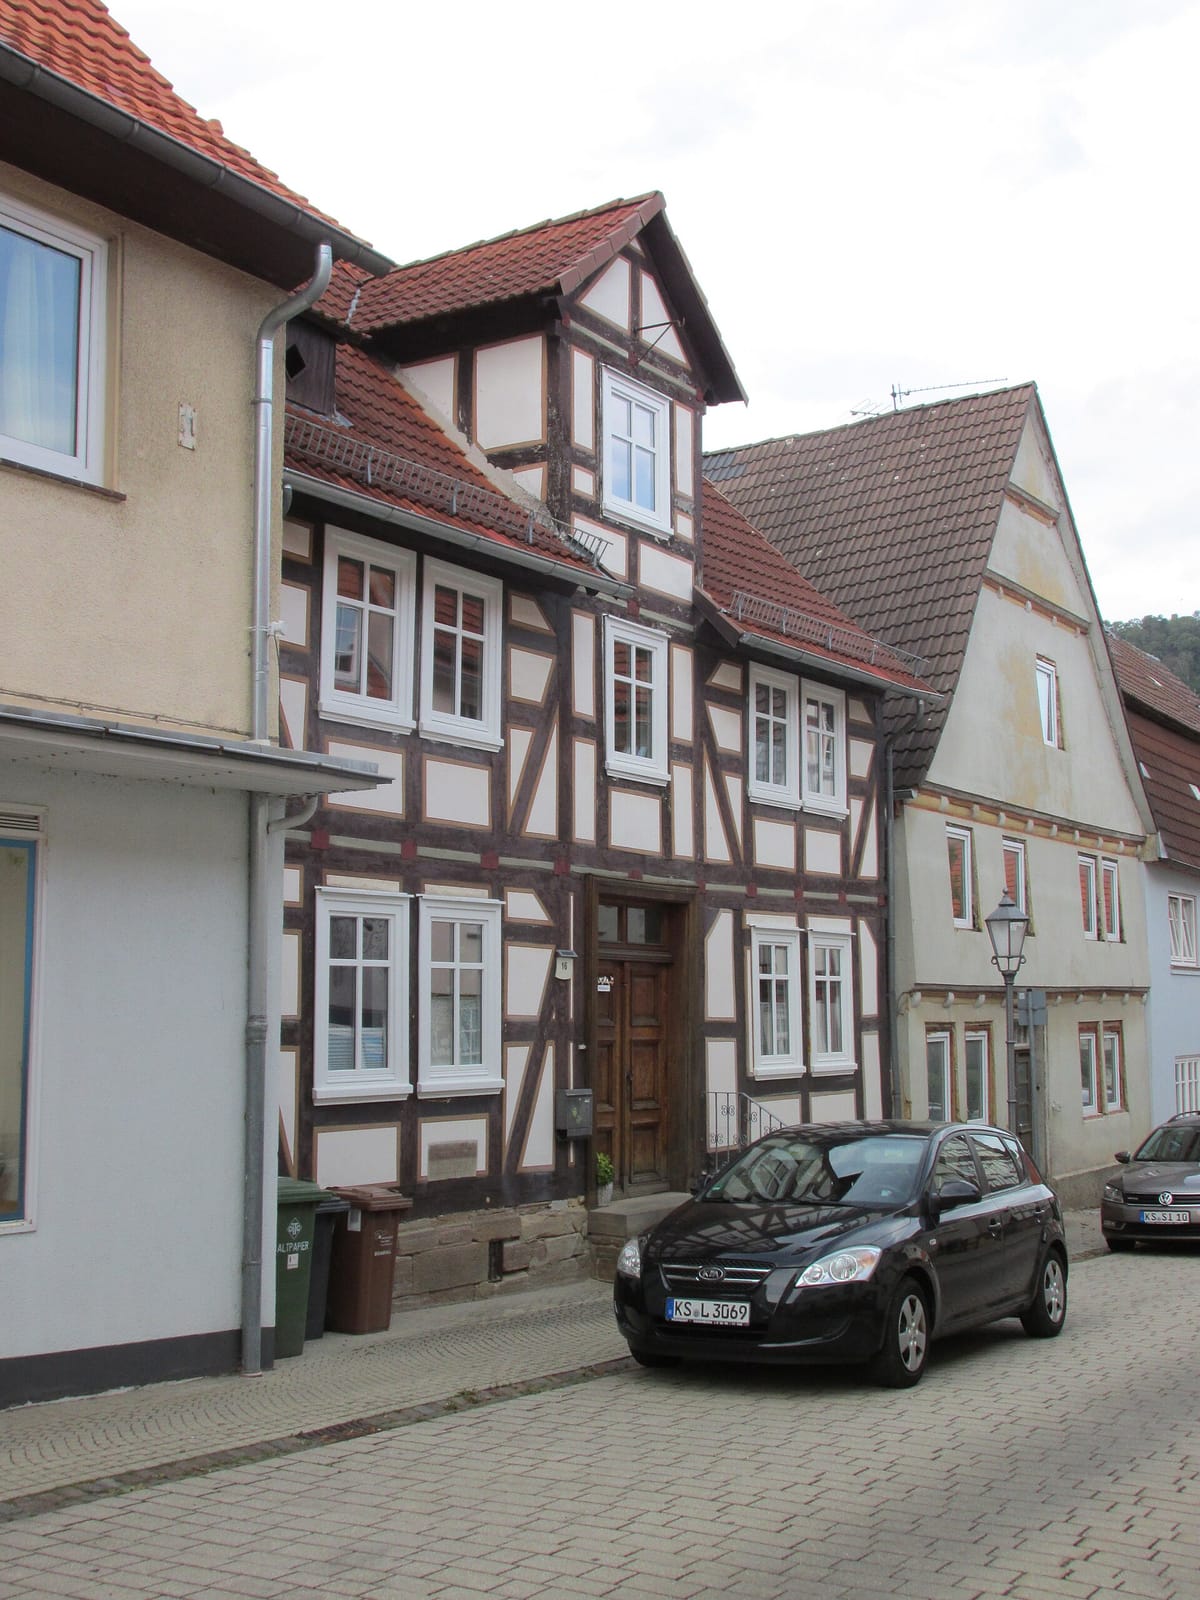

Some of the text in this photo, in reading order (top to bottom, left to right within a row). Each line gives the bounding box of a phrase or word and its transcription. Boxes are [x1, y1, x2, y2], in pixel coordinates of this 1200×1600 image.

[1144, 1212, 1157, 1221] KS
[1176, 1213, 1188, 1222] 10
[277, 1241, 309, 1253] ALTPAPIER
[675, 1301, 747, 1320] KS L 3069
